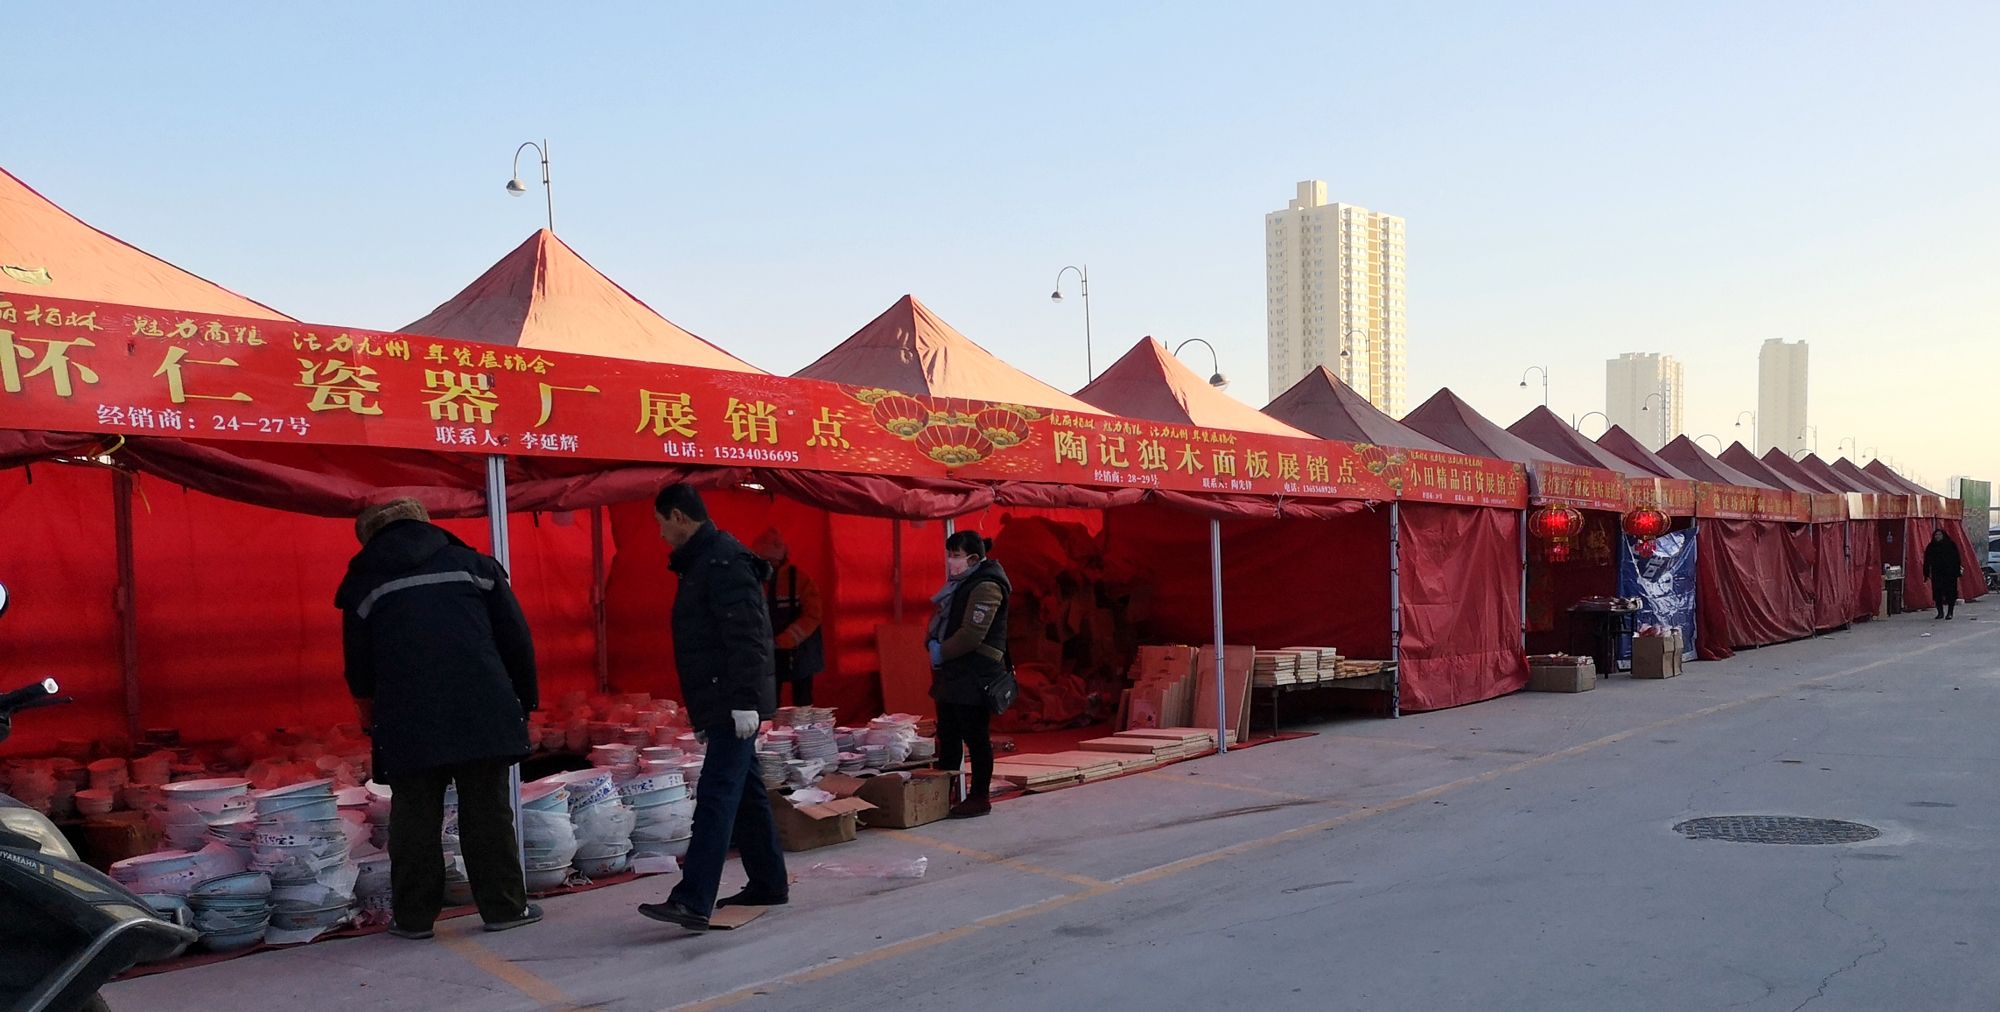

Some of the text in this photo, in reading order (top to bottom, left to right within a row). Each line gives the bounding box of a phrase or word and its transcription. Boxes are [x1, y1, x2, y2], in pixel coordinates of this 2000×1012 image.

[0, 328, 851, 449] 怀仁瓷器厂展销点
[663, 439, 799, 462] 电话：15234036695
[1053, 430, 1357, 485] 陶记独木面板展销点
